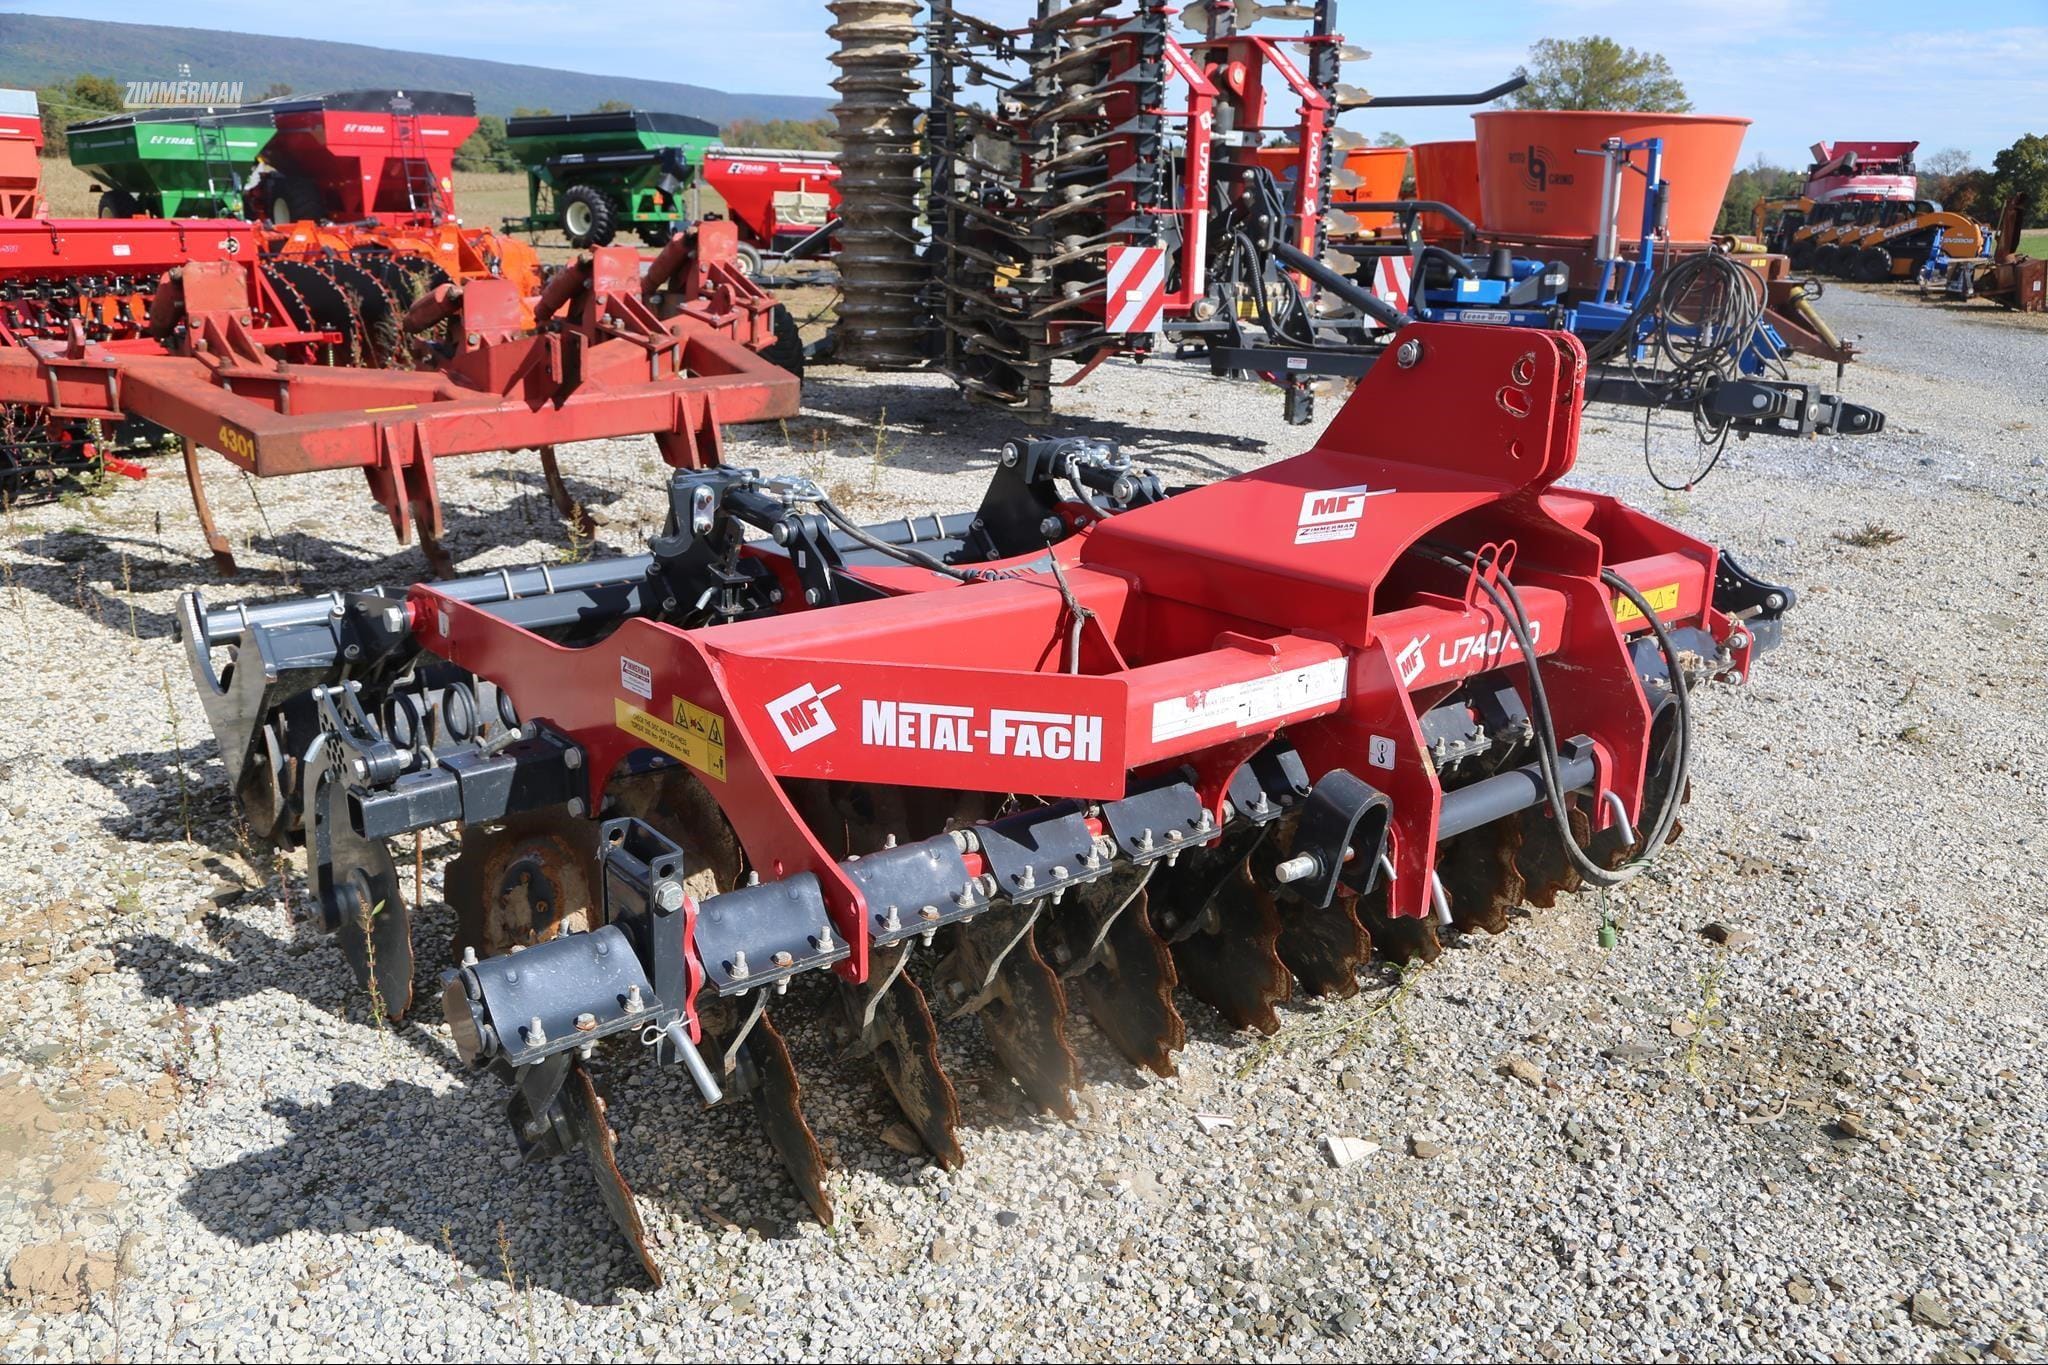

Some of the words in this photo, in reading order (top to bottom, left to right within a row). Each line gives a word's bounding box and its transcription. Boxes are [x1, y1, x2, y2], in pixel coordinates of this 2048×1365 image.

[357, 124, 386, 134] TRAIL
[165, 136, 196, 145] TRAIL
[1883, 219, 1918, 238] CASE
[219, 425, 255, 461] 4301
[1311, 495, 1356, 516] MF
[1299, 523, 1355, 536] ZIMMERMAN
[1401, 651, 1419, 677] MF
[781, 701, 819, 736] MF
[861, 699, 1103, 763] METAL-FACH
